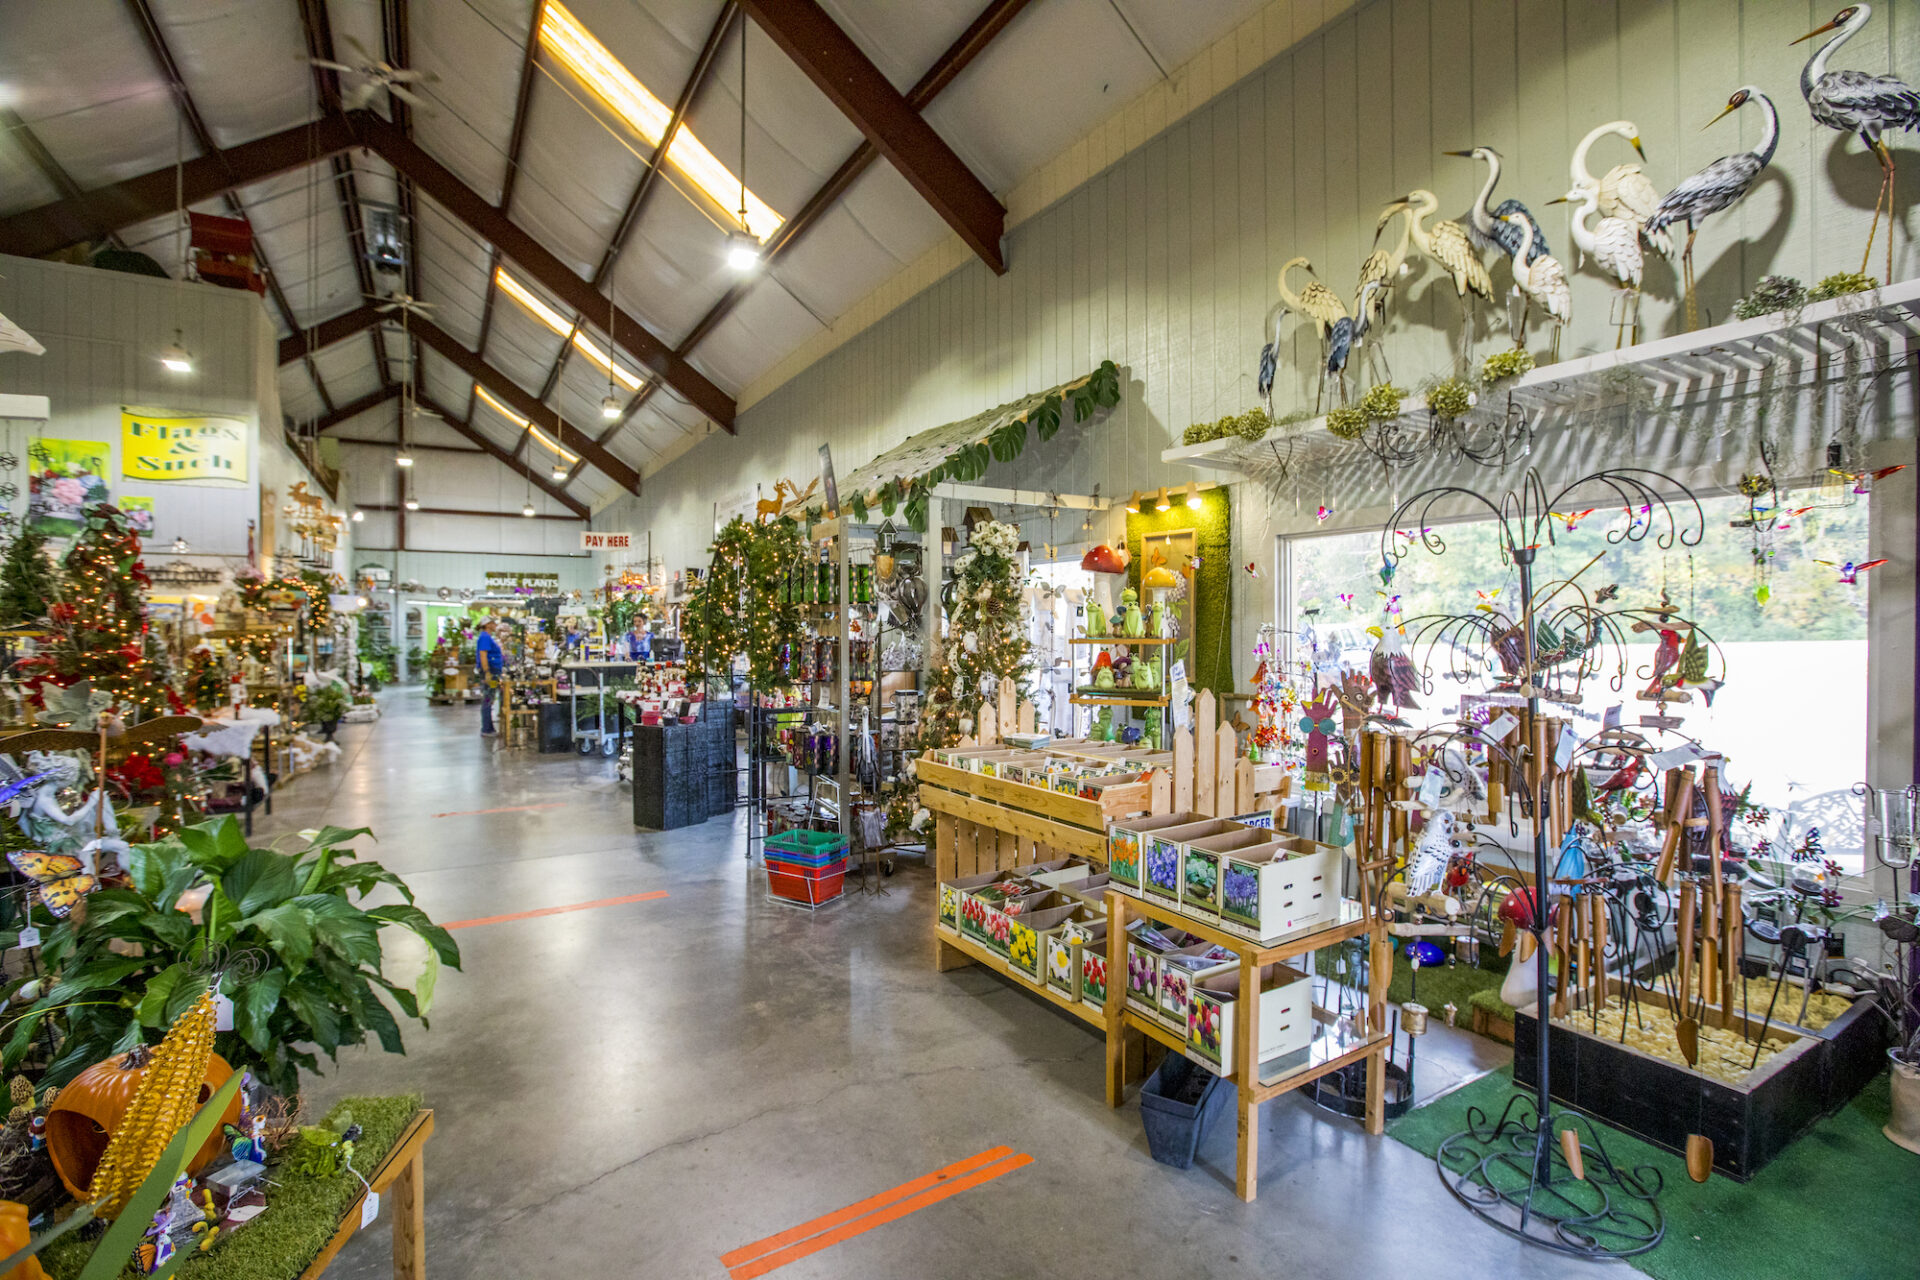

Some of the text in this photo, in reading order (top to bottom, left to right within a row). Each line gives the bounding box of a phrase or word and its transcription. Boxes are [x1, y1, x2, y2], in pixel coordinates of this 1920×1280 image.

[131, 421, 240, 441] Flags
[168, 441, 201, 455] &
[136, 454, 232, 471] Such
[585, 535, 629, 547] PAY HERE
[485, 577, 558, 588] HOUSE PLANTS
